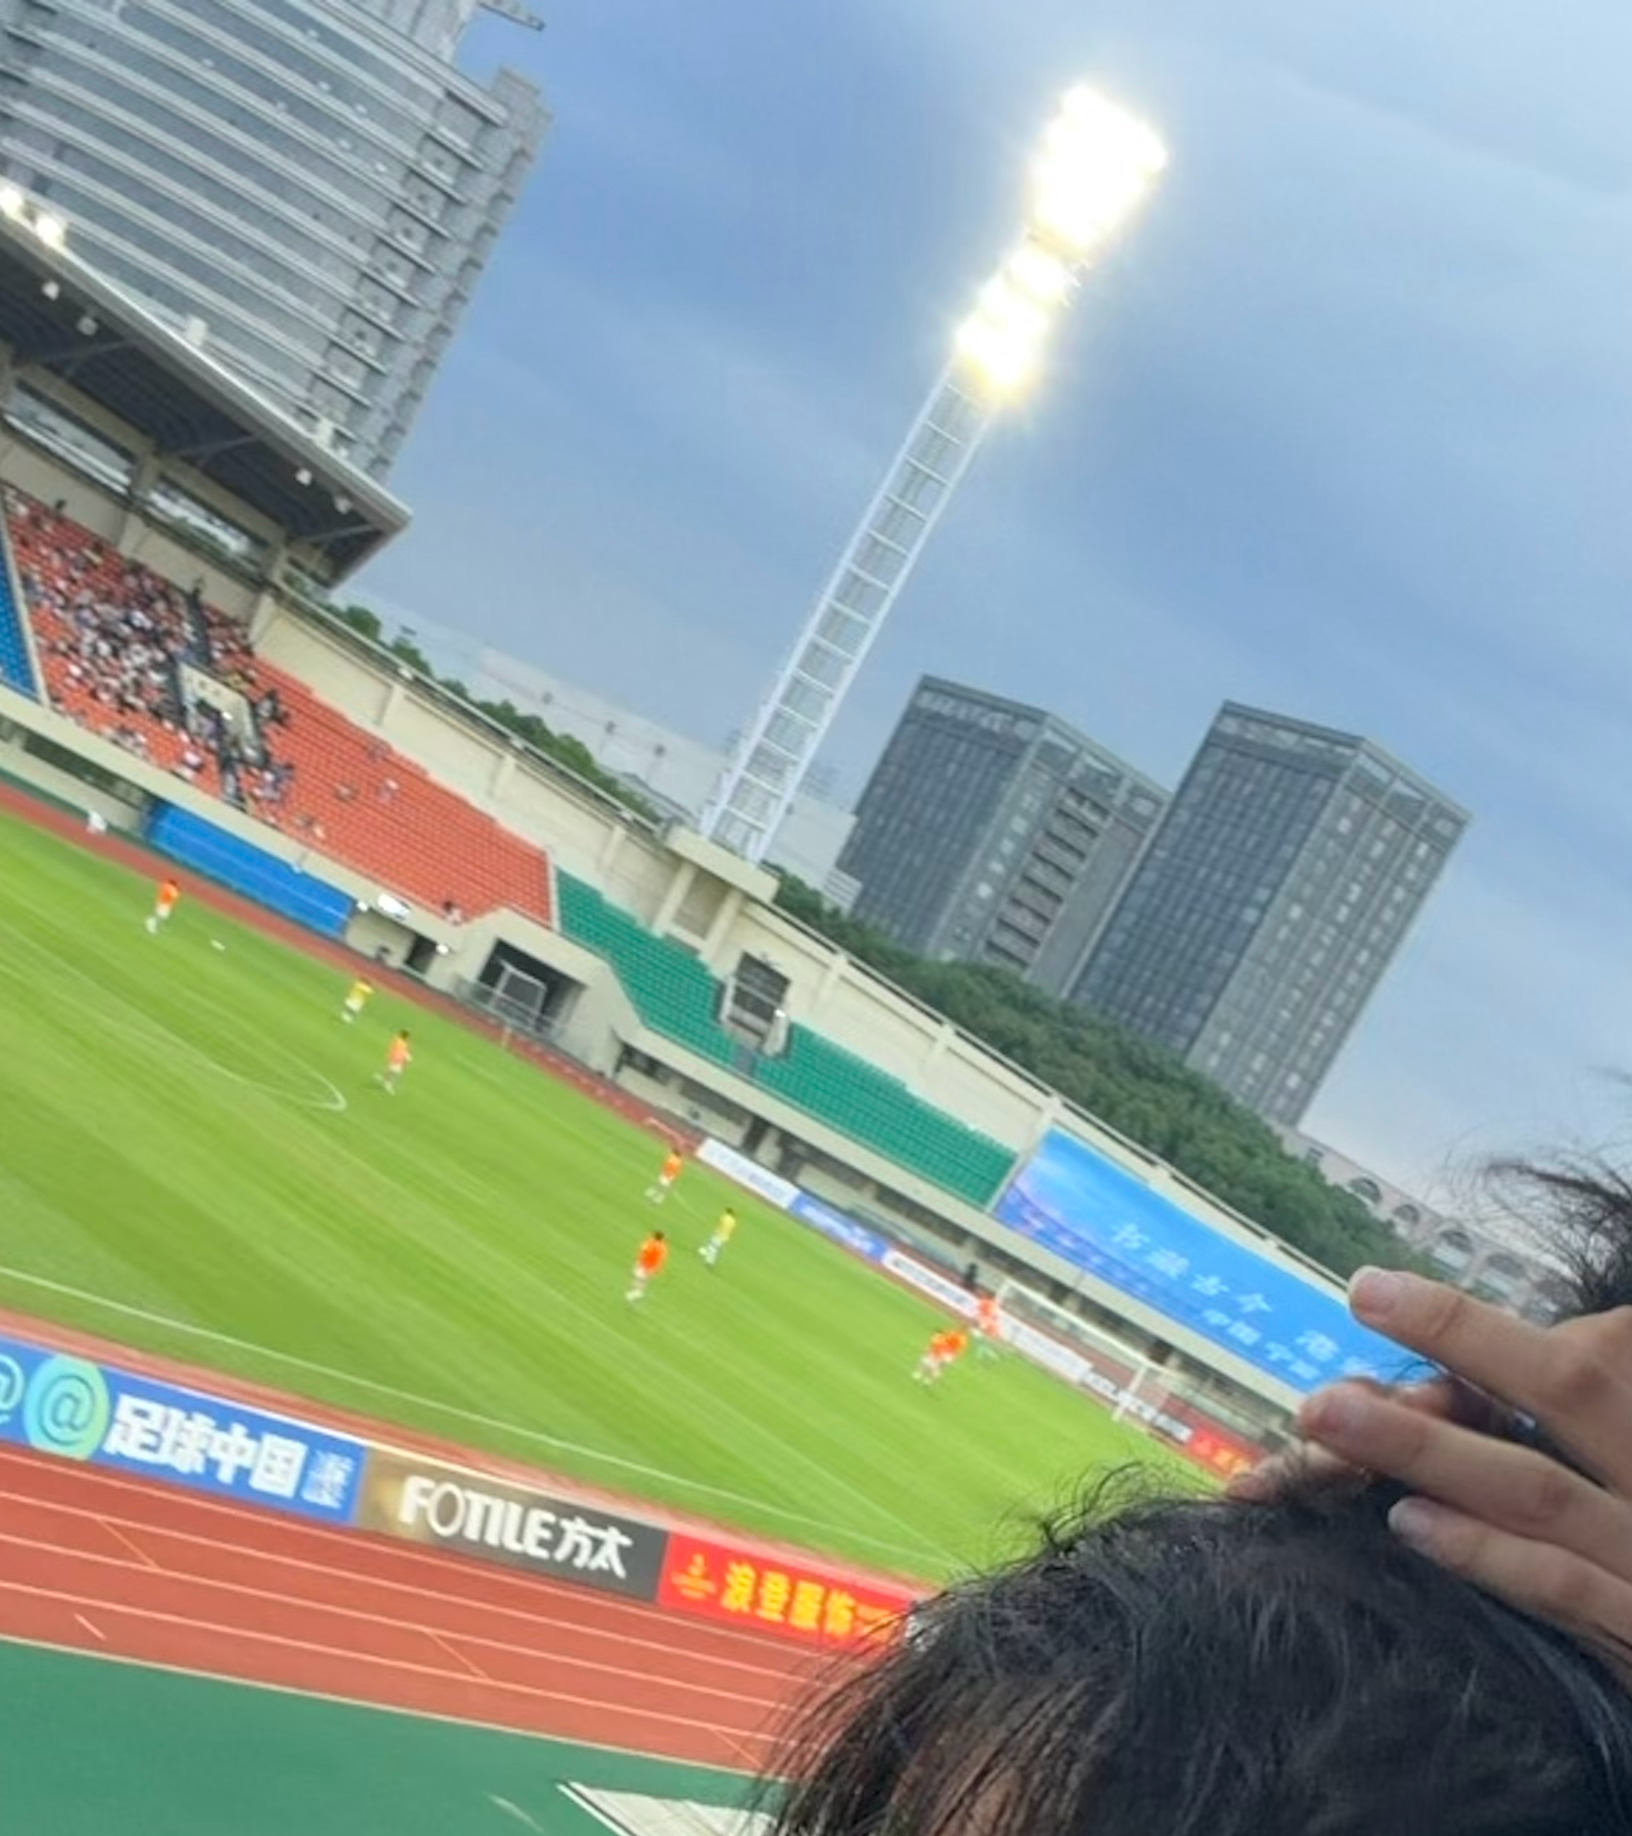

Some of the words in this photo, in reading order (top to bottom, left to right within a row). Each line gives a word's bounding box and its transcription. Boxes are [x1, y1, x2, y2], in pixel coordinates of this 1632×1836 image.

[102, 1393, 308, 1498] 足球中国
[398, 1474, 557, 1560] FOTILE
[553, 1516, 634, 1580] 方太
